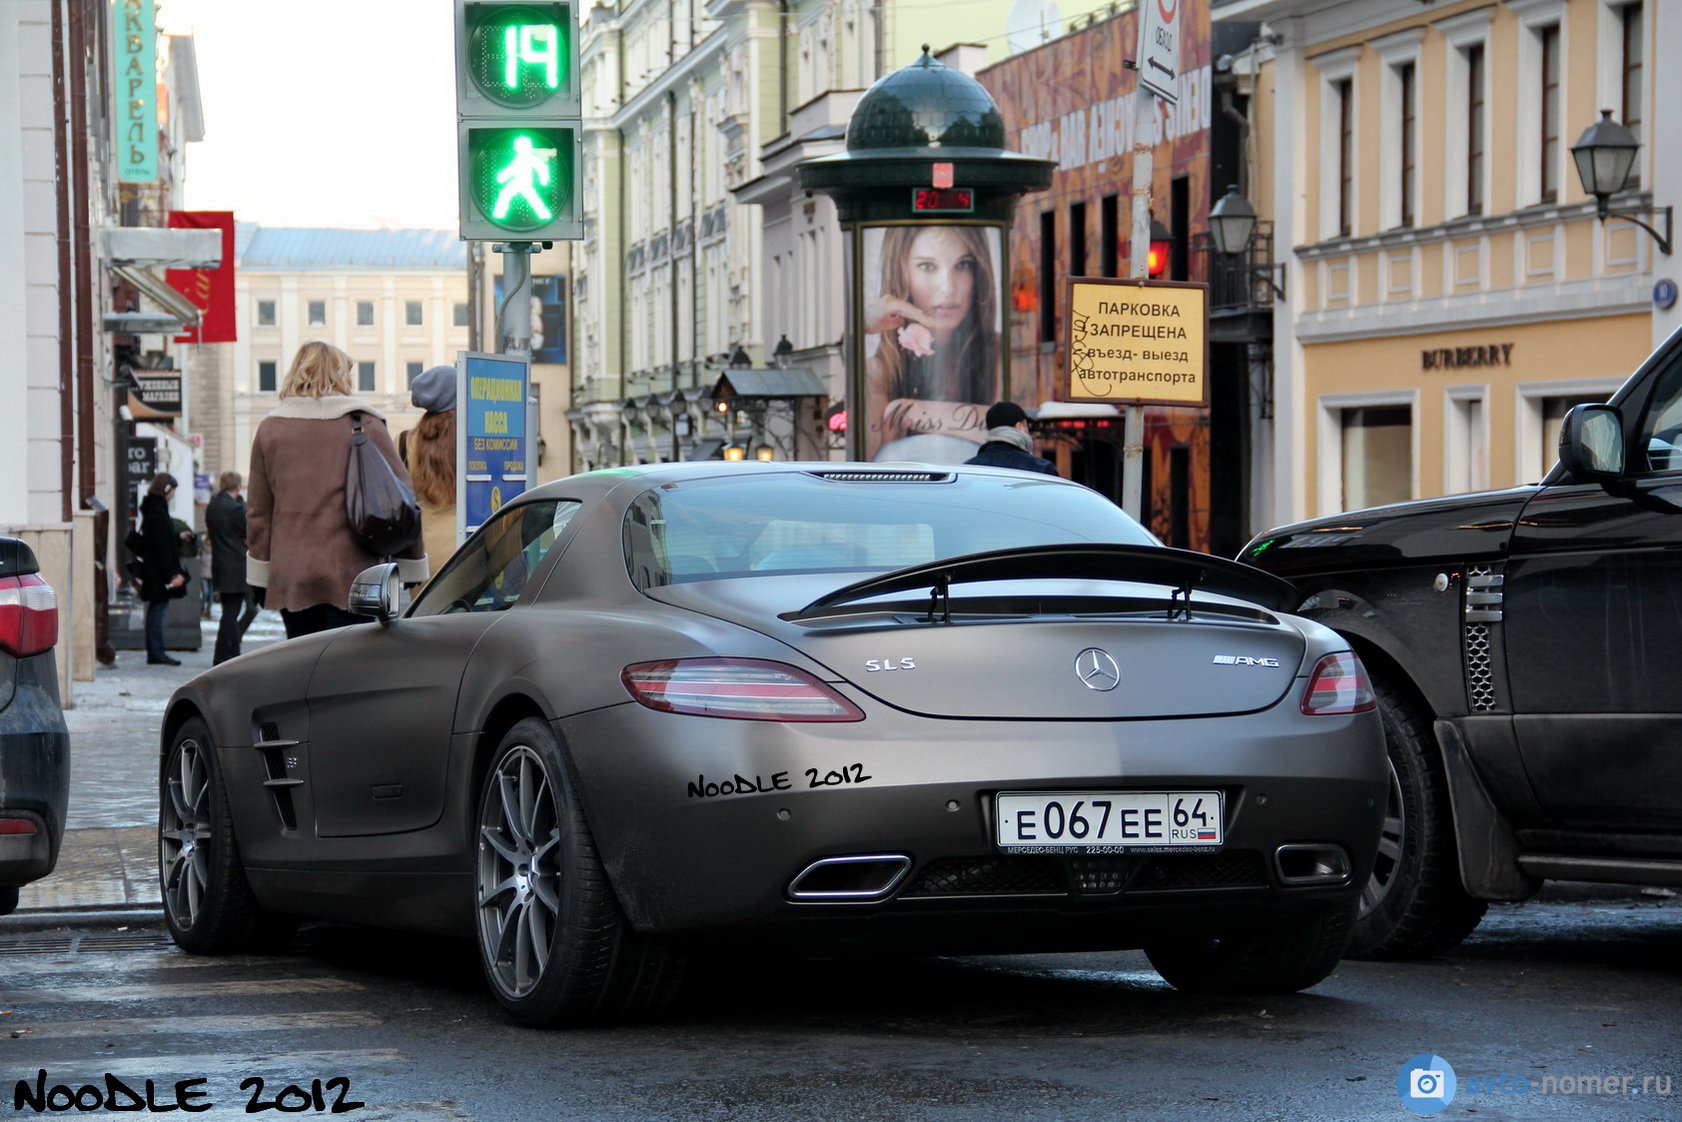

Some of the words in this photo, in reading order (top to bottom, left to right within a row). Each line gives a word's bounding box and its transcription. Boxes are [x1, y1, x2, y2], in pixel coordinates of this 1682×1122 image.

[505, 24, 558, 88] 19
[1099, 302, 1180, 317] ПАРКОВКА
[1090, 323, 1187, 340] ЗАПРЕЩЕНА
[1143, 350, 1188, 363] выезд
[1423, 343, 1514, 370] BURBERRY
[1079, 369, 1196, 385] автотранспорта
[871, 402, 943, 432] Miss
[474, 438, 485, 450] БЕЗ
[866, 657, 915, 672] SLS
[1173, 798, 1207, 827] 64
[1172, 829, 1196, 839] RUS
